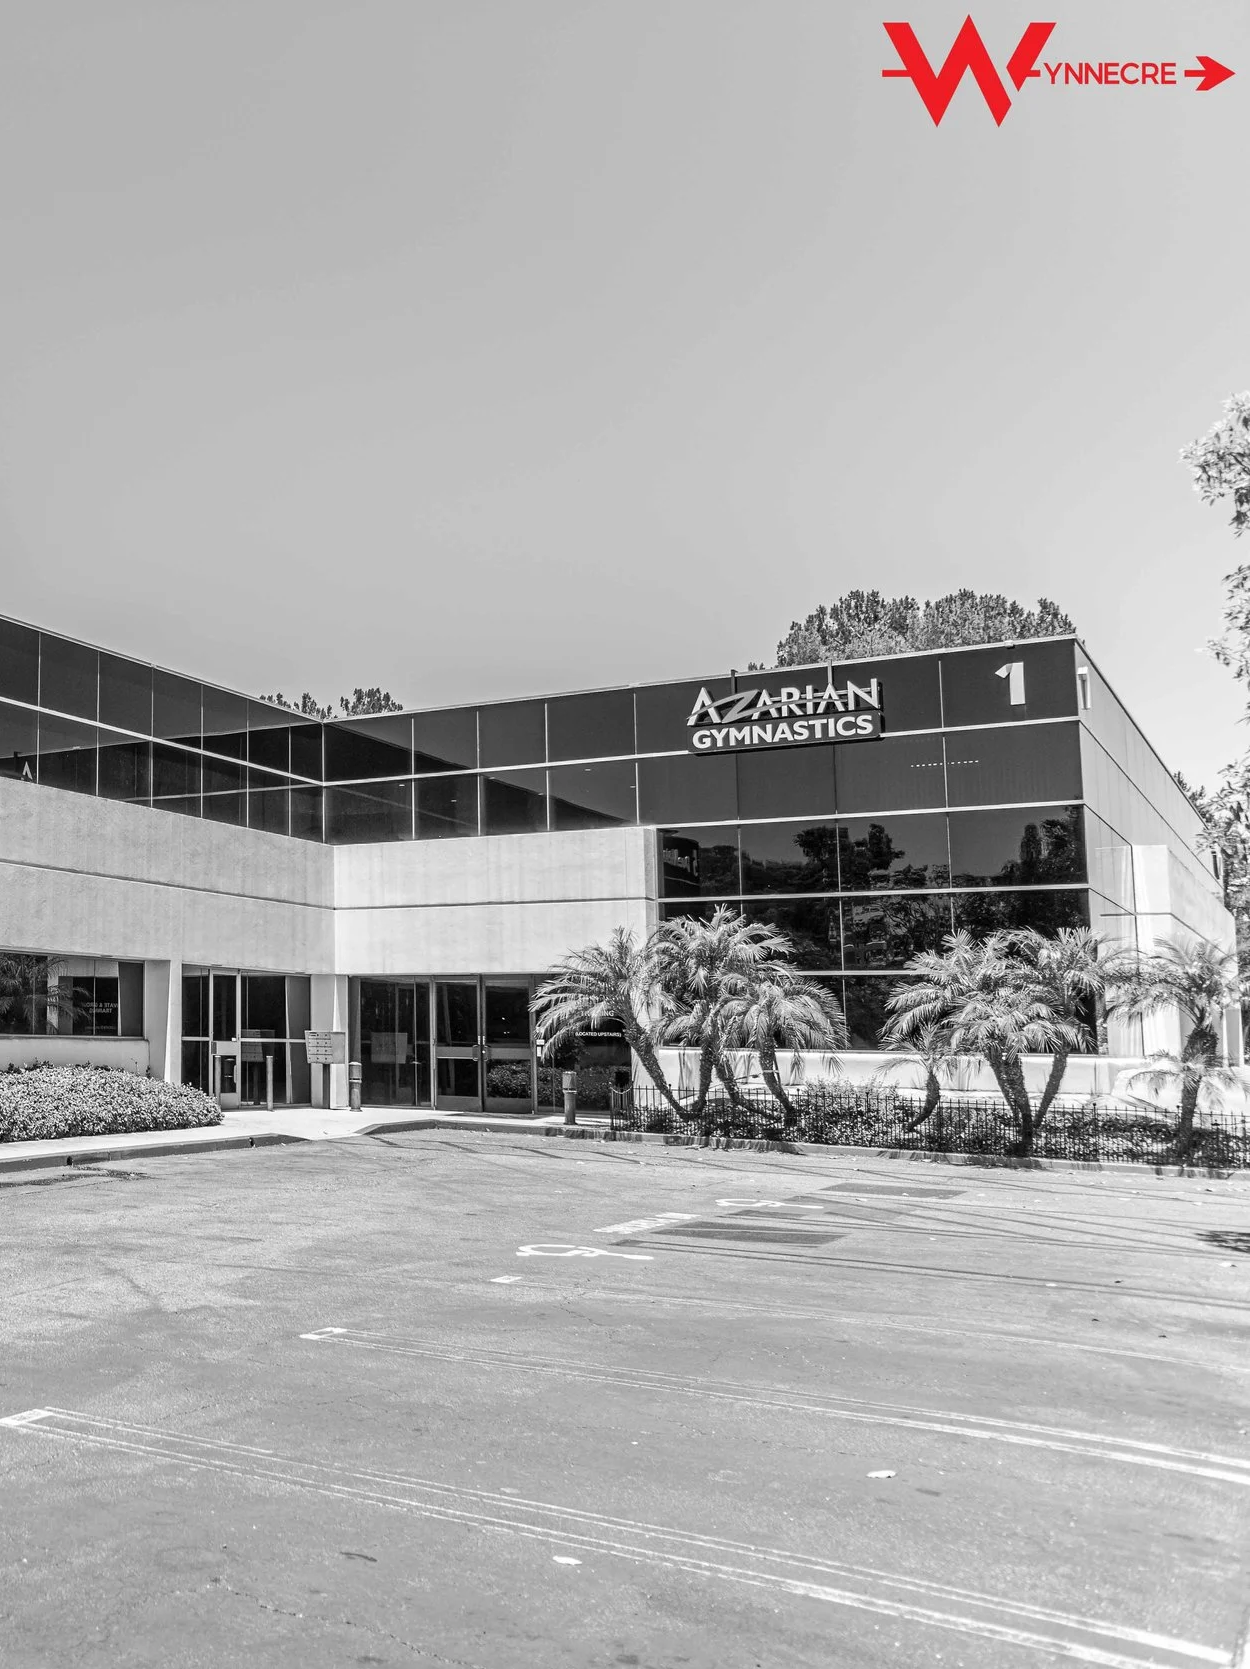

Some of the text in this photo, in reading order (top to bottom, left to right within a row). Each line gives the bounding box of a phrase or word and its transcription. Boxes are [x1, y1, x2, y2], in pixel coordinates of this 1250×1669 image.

[687, 678, 881, 726] AZARIAN
[995, 662, 1025, 705] 1
[692, 715, 874, 749] GYMNASTICS
